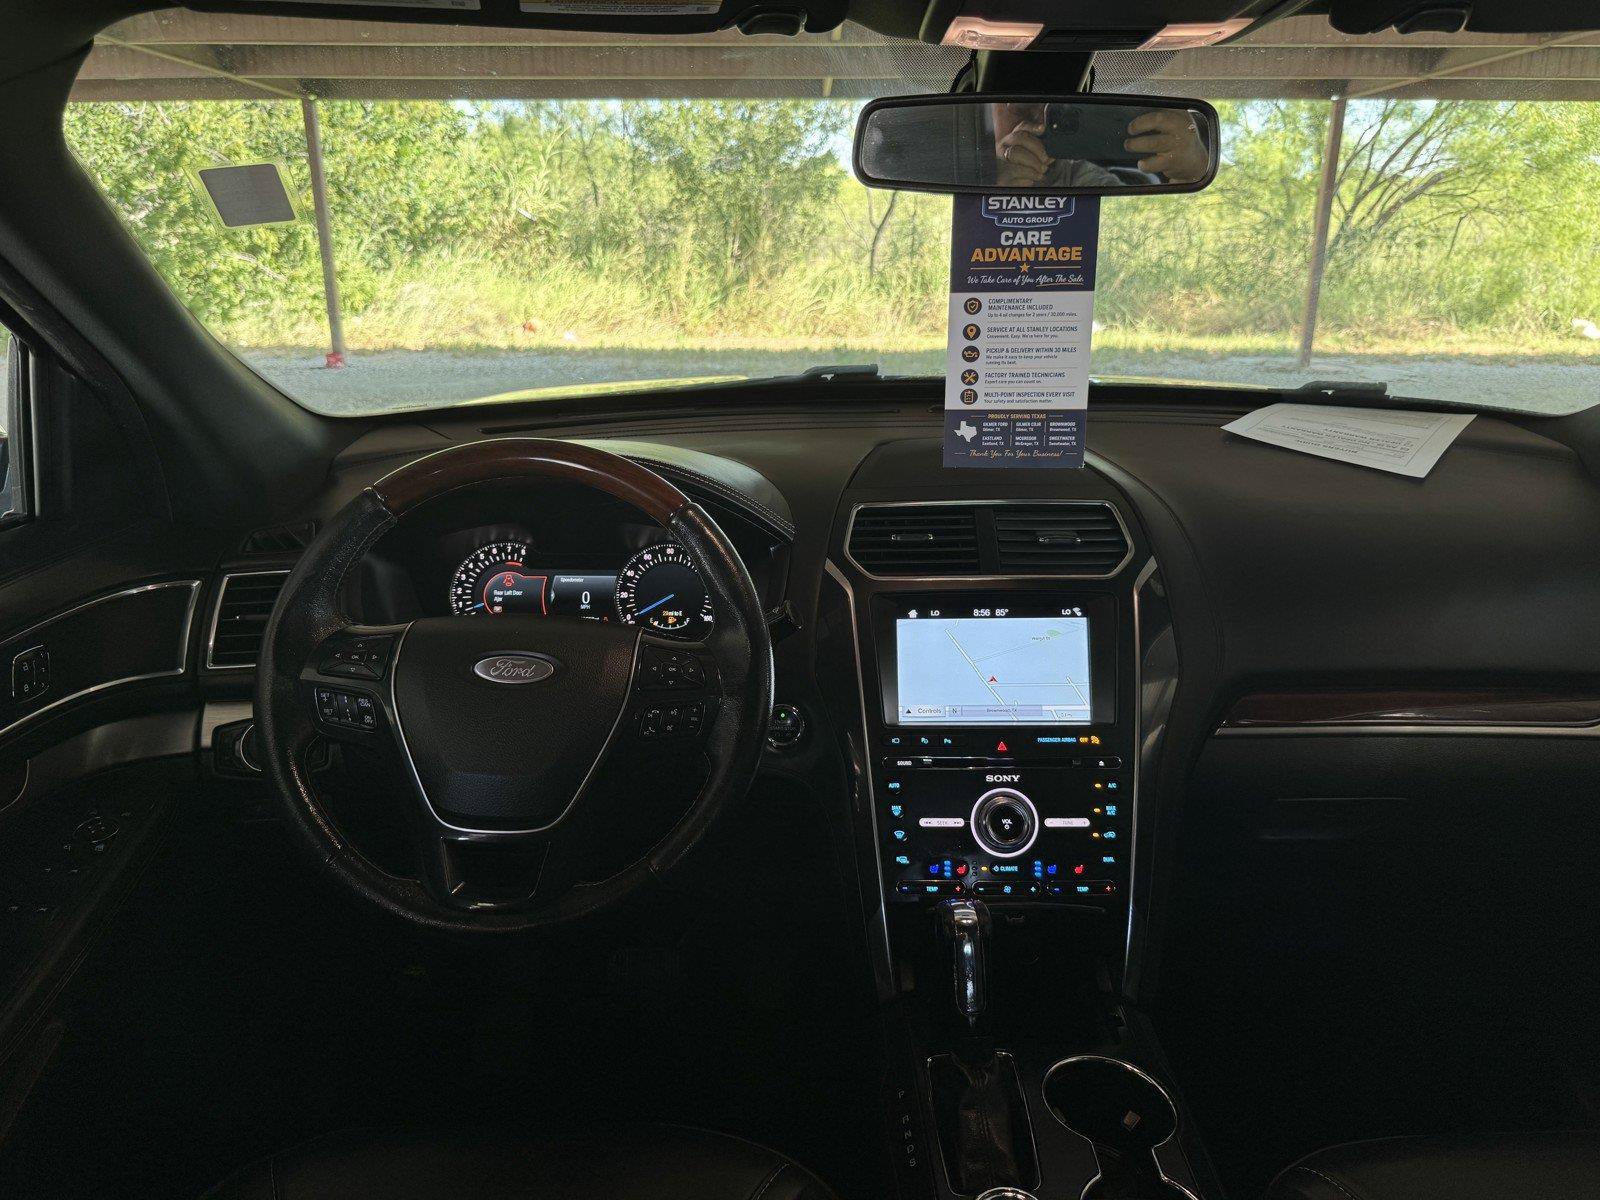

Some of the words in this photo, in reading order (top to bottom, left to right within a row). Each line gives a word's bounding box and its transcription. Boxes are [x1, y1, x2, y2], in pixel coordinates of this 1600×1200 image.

[988, 196, 1067, 210] STANLEY
[1000, 230, 1052, 246] CARE
[970, 246, 1082, 262] ADVANTAGE
[967, 276, 978, 284] We
[980, 276, 995, 284] Take
[1013, 275, 1020, 285] of
[1022, 276, 1035, 285] You
[1036, 275, 1053, 284] After
[1055, 274, 1067, 282] The
[990, 450, 1002, 458] You
[1016, 450, 1031, 458] Your
[582, 591, 590, 604] 0
[973, 609, 990, 617] 8:56
[490, 658, 536, 678] Ford
[899, 1090, 904, 1098] P
[905, 1130, 912, 1139] N
[907, 1144, 914, 1153] D
